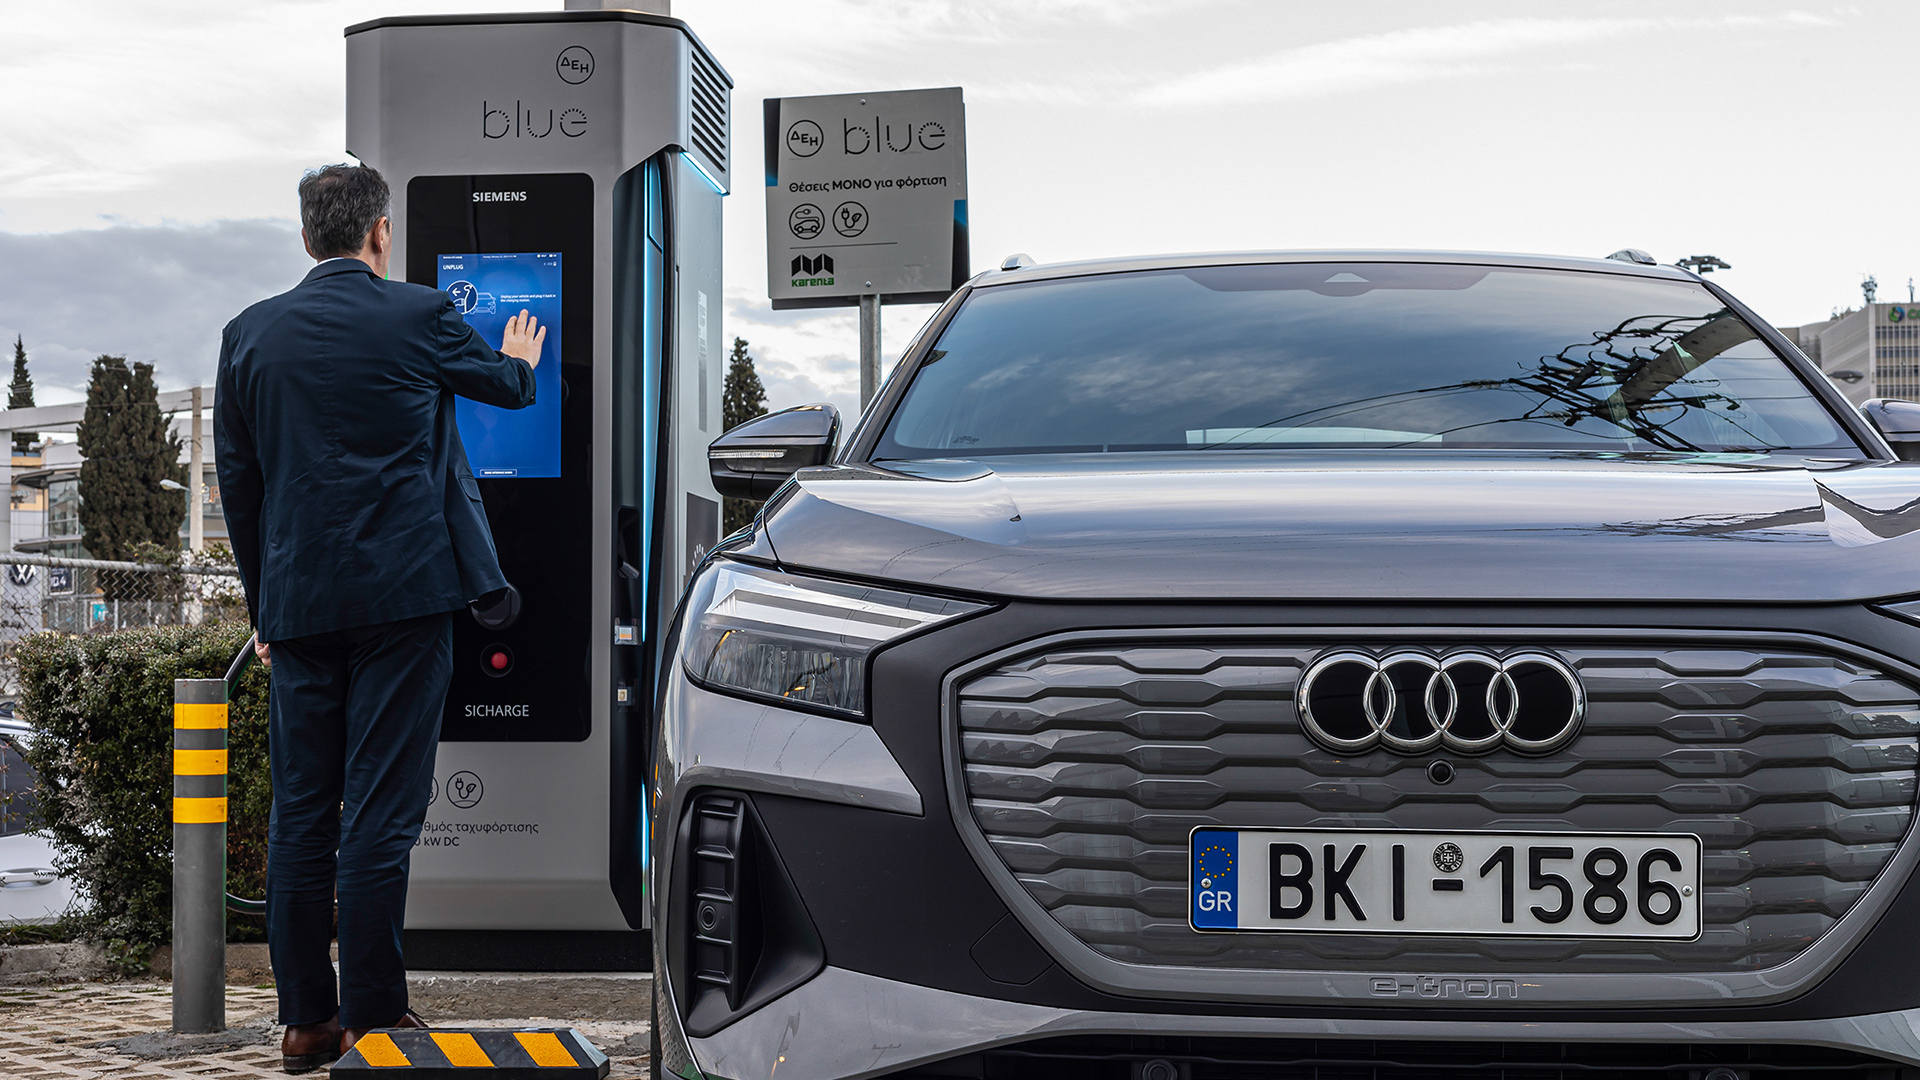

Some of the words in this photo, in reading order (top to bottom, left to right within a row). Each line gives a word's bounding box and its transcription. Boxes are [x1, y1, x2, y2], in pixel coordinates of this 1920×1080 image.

[560, 56, 589, 73] ΔΕΗ
[483, 100, 588, 139] blue
[790, 130, 819, 147] ΔΕΗ
[843, 116, 946, 155] blue
[788, 181, 830, 193] Θέσεις
[874, 178, 893, 191] για
[895, 176, 947, 190] φόρτιση
[472, 191, 528, 202] SIEMENS
[464, 704, 530, 717] SICHARGE
[424, 821, 452, 834] θμός
[455, 821, 539, 834] ταχυφόρτισης
[424, 836, 442, 846] kW
[444, 836, 460, 847] DC
[1198, 890, 1233, 912] GR
[1369, 975, 1518, 998] e-tron
